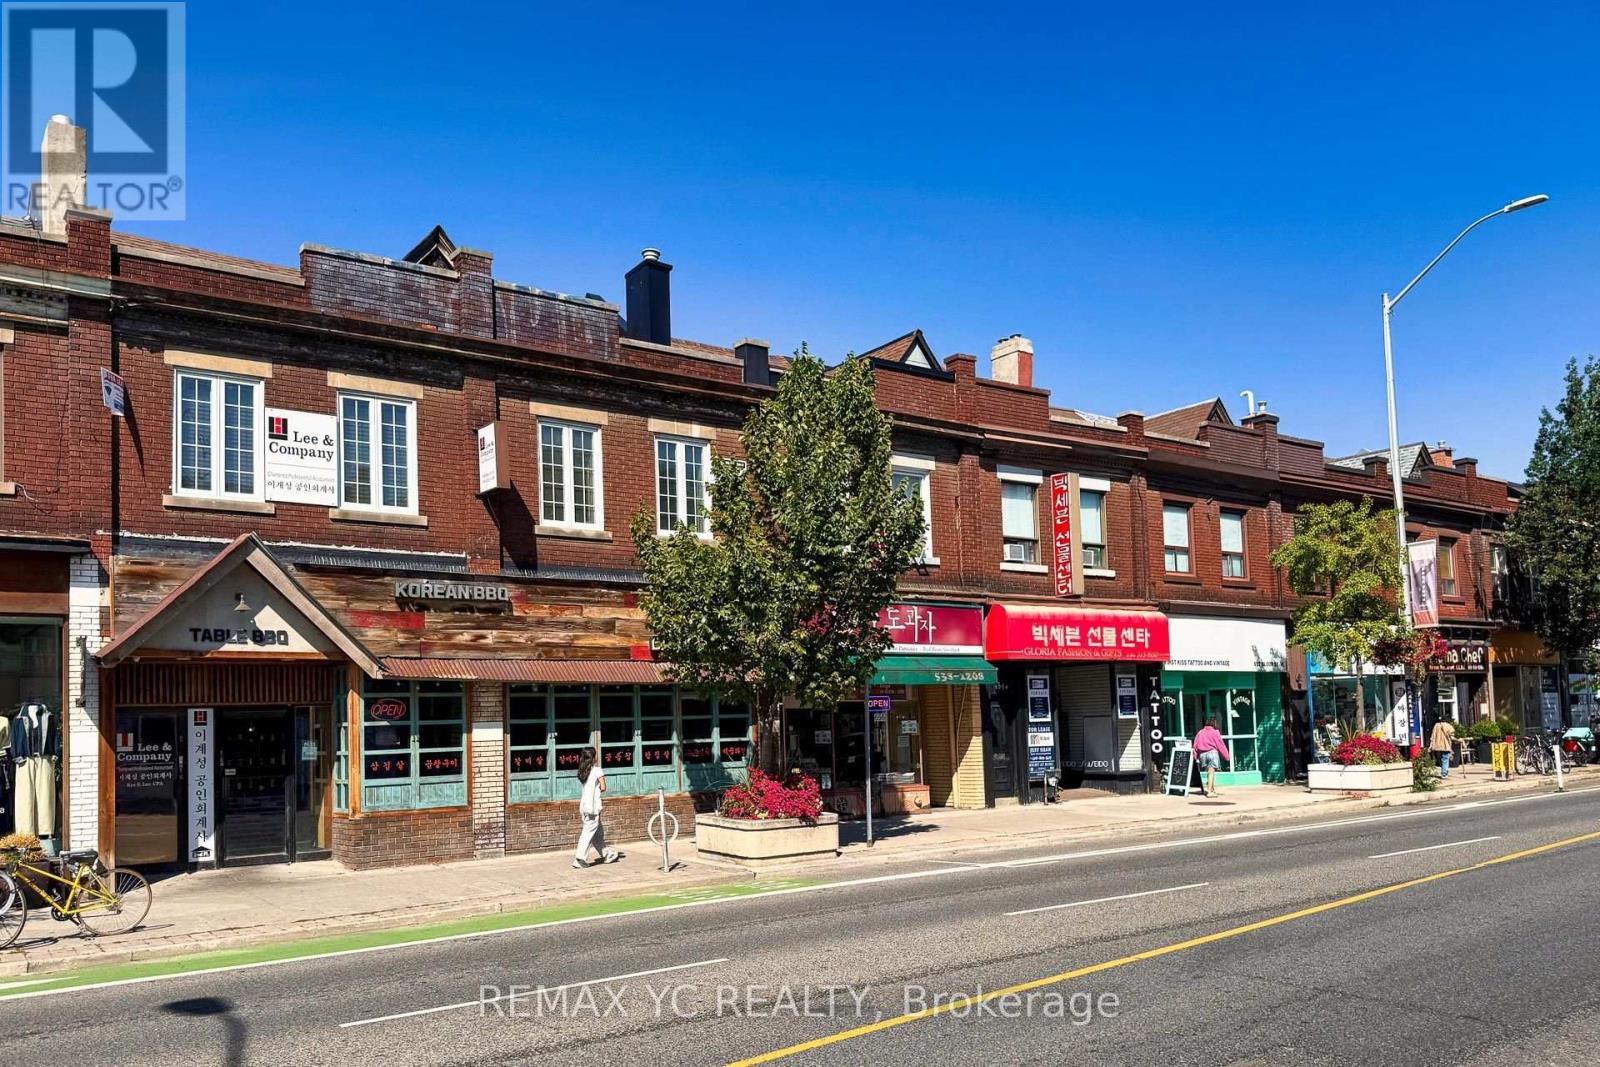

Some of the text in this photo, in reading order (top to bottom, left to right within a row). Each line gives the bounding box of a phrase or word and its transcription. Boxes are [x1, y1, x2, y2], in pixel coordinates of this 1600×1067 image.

[293, 430, 334, 446] Lee &
[269, 441, 334, 462] Company
[395, 581, 511, 601] KOREAN BBQ
[872, 605, 936, 643] 도과자
[189, 628, 289, 647] TABLE BBQ
[1087, 627, 1117, 648] 선물
[1120, 628, 1151, 648] 센타
[1024, 647, 1056, 657] GLORIA
[1057, 648, 1092, 657] FASHION
[1101, 649, 1122, 657] GIFTS
[1460, 647, 1483, 663] Chef
[868, 700, 889, 708] OPEN
[1232, 696, 1251, 706] VINTAGE
[373, 704, 403, 716] OPEN
[1150, 677, 1163, 753] TATTOO
[137, 742, 172, 751] Lee &
[195, 729, 208, 769] 이계성
[117, 753, 172, 763] Company
[194, 775, 208, 843] 공인회계사
